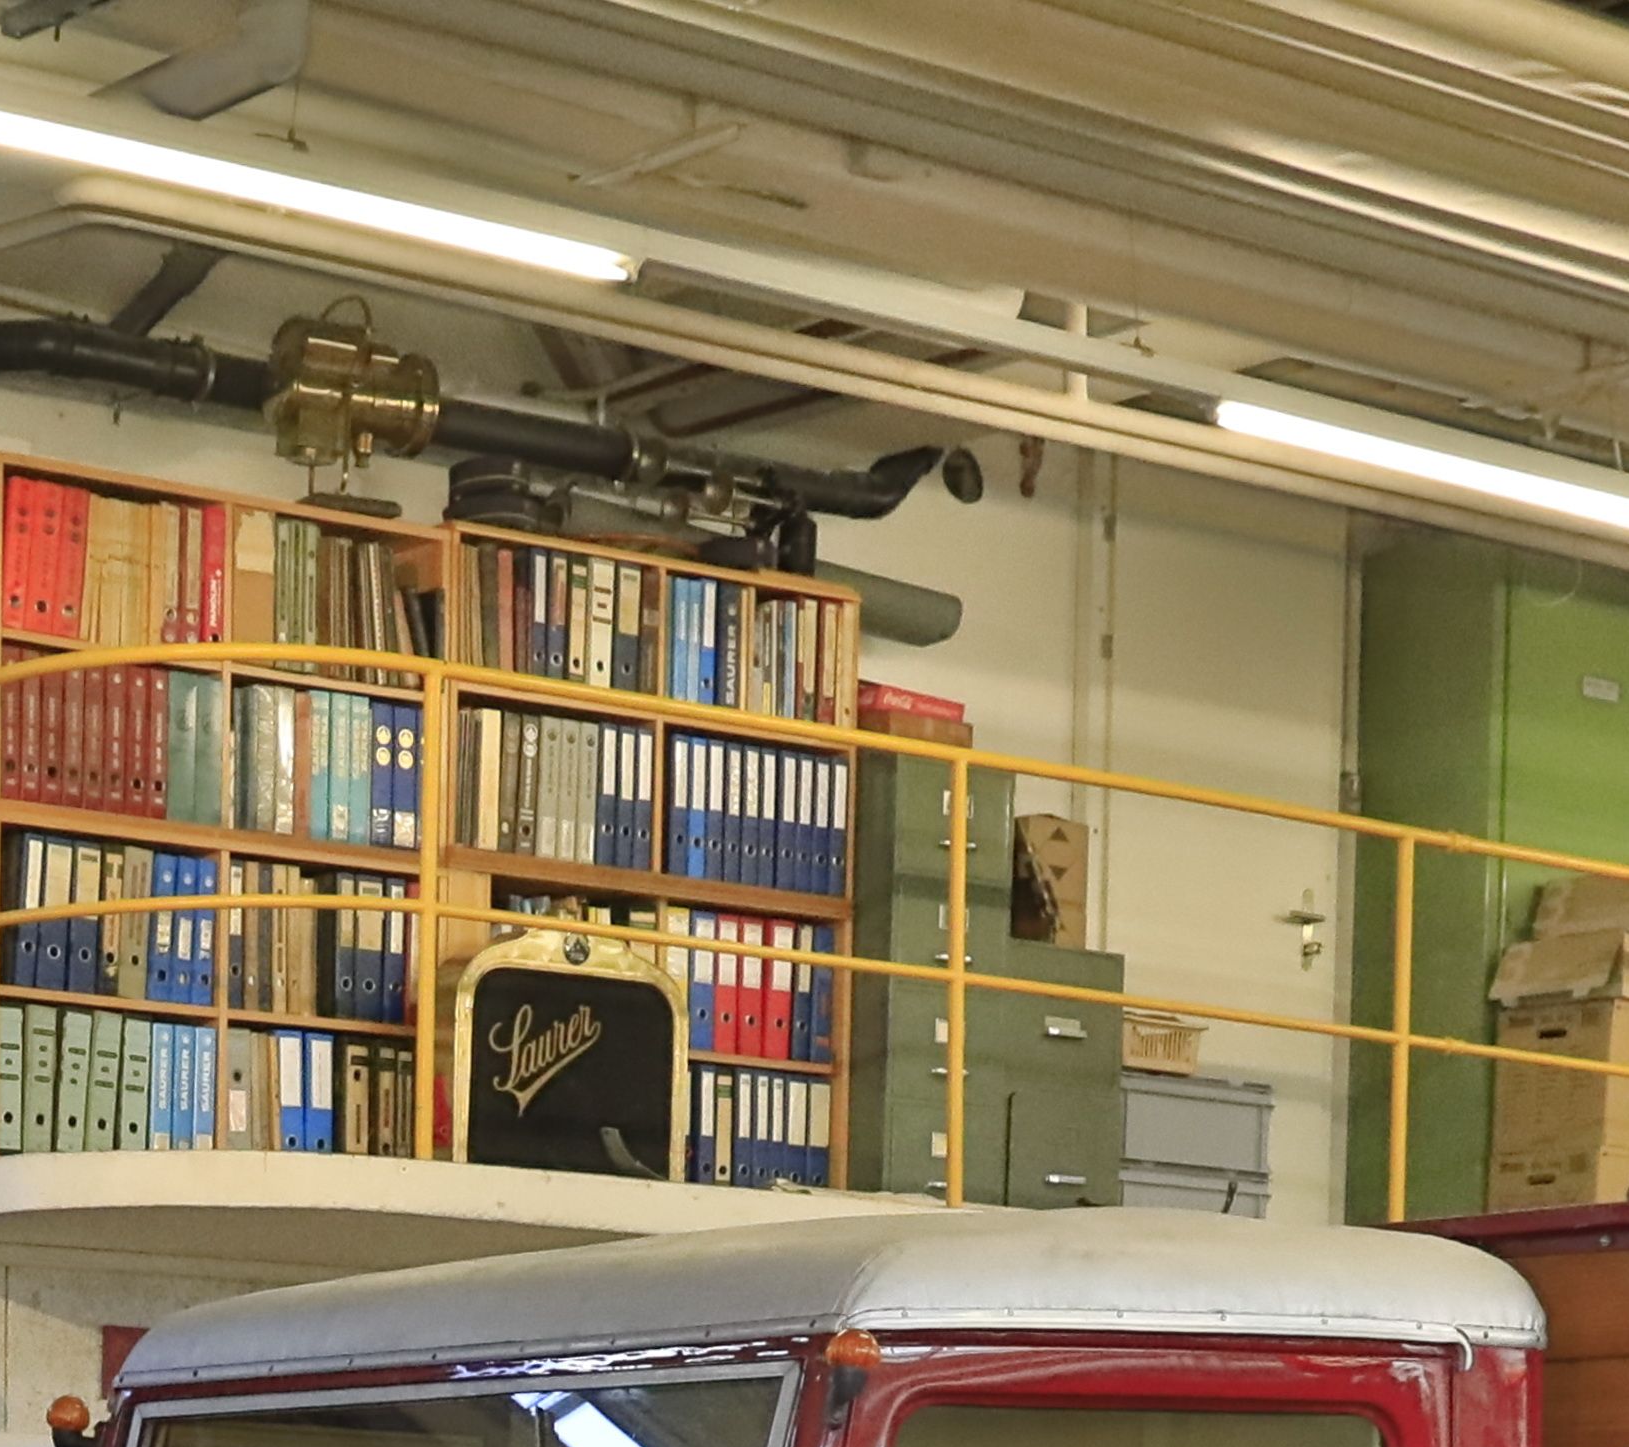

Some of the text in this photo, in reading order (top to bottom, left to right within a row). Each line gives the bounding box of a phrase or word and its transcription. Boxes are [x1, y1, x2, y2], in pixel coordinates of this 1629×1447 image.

[725, 624, 737, 705] SAURER
[158, 1048, 169, 1110] SAURER
[180, 1048, 191, 1112] SAURER
[201, 1051, 212, 1113] SAURER
[488, 1003, 602, 1117] Saurer
